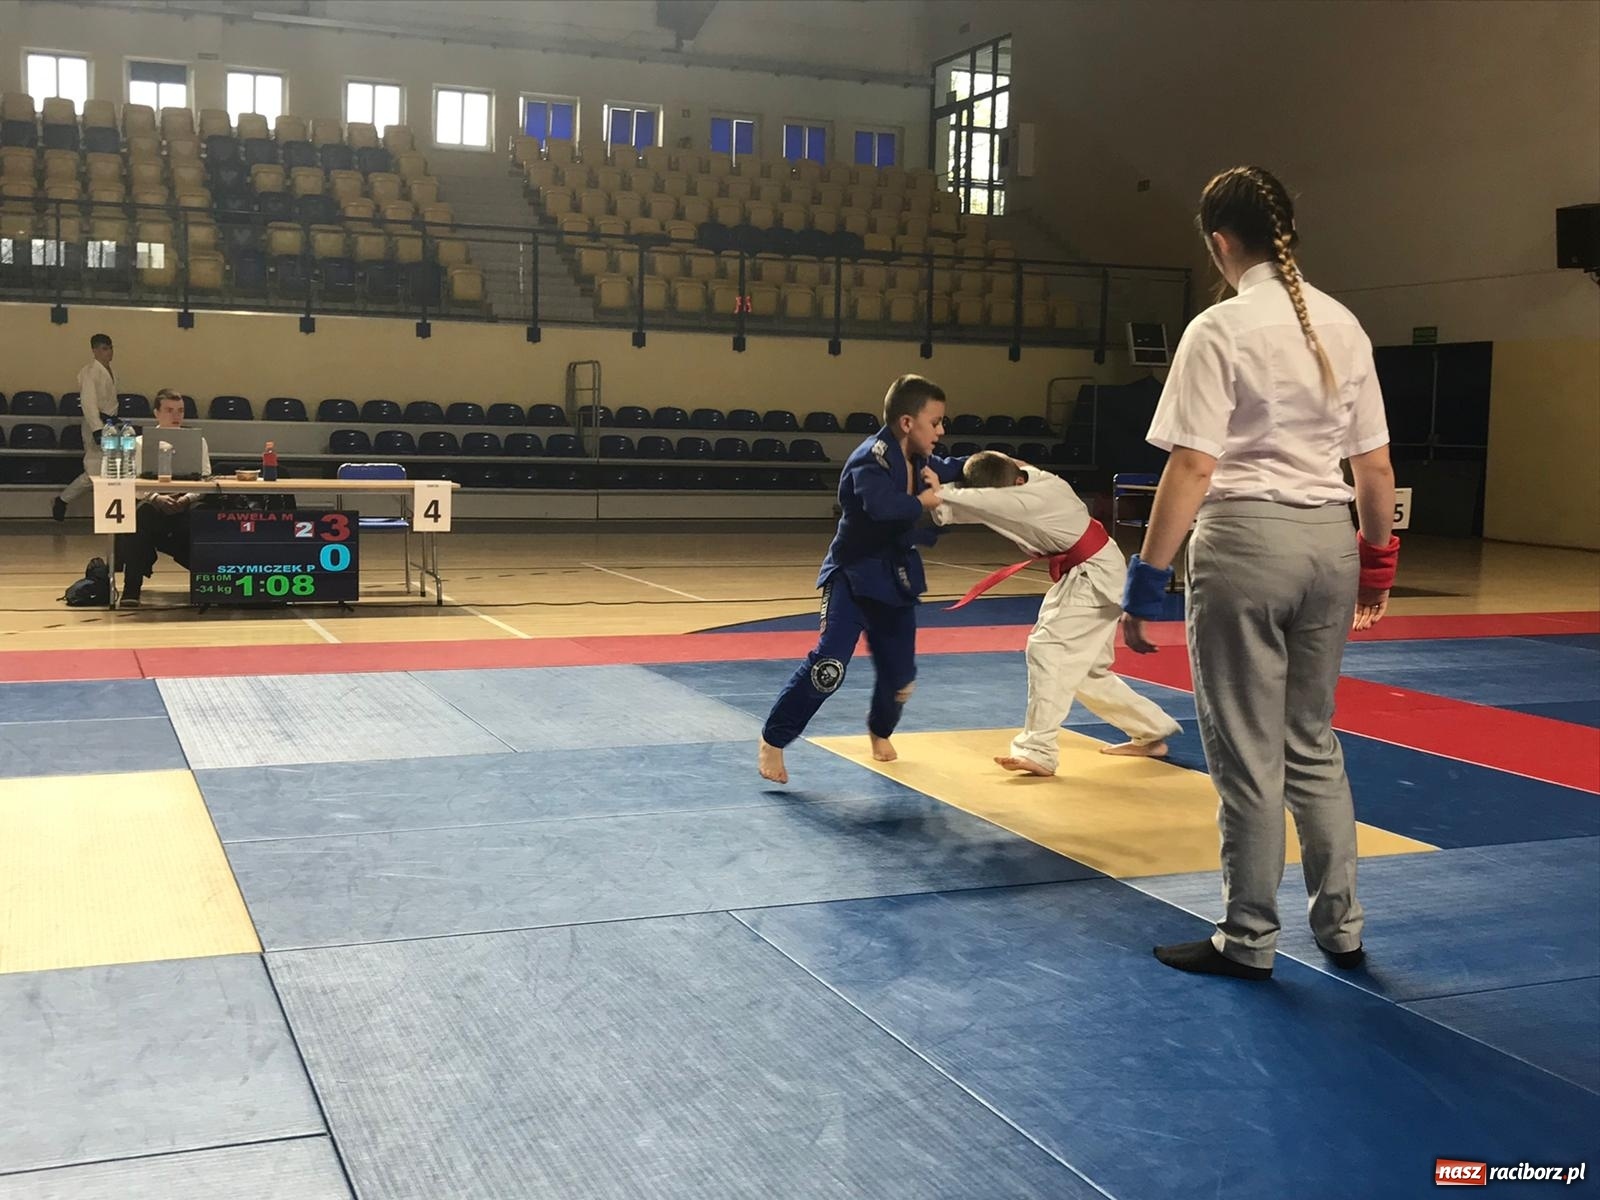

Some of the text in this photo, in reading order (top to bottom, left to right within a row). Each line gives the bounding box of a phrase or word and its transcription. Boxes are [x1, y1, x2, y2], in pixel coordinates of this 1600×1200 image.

[105, 499, 125, 524] 4
[282, 513, 294, 521] M
[424, 499, 442, 523] 4
[1393, 503, 1404, 523] 5
[242, 522, 252, 532] 1
[295, 521, 314, 538] 2
[319, 513, 351, 542] 3
[319, 543, 351, 572] 0
[217, 564, 316, 573] SZYMICZEK P
[217, 585, 232, 595] kg
[235, 574, 316, 597] 1:08
